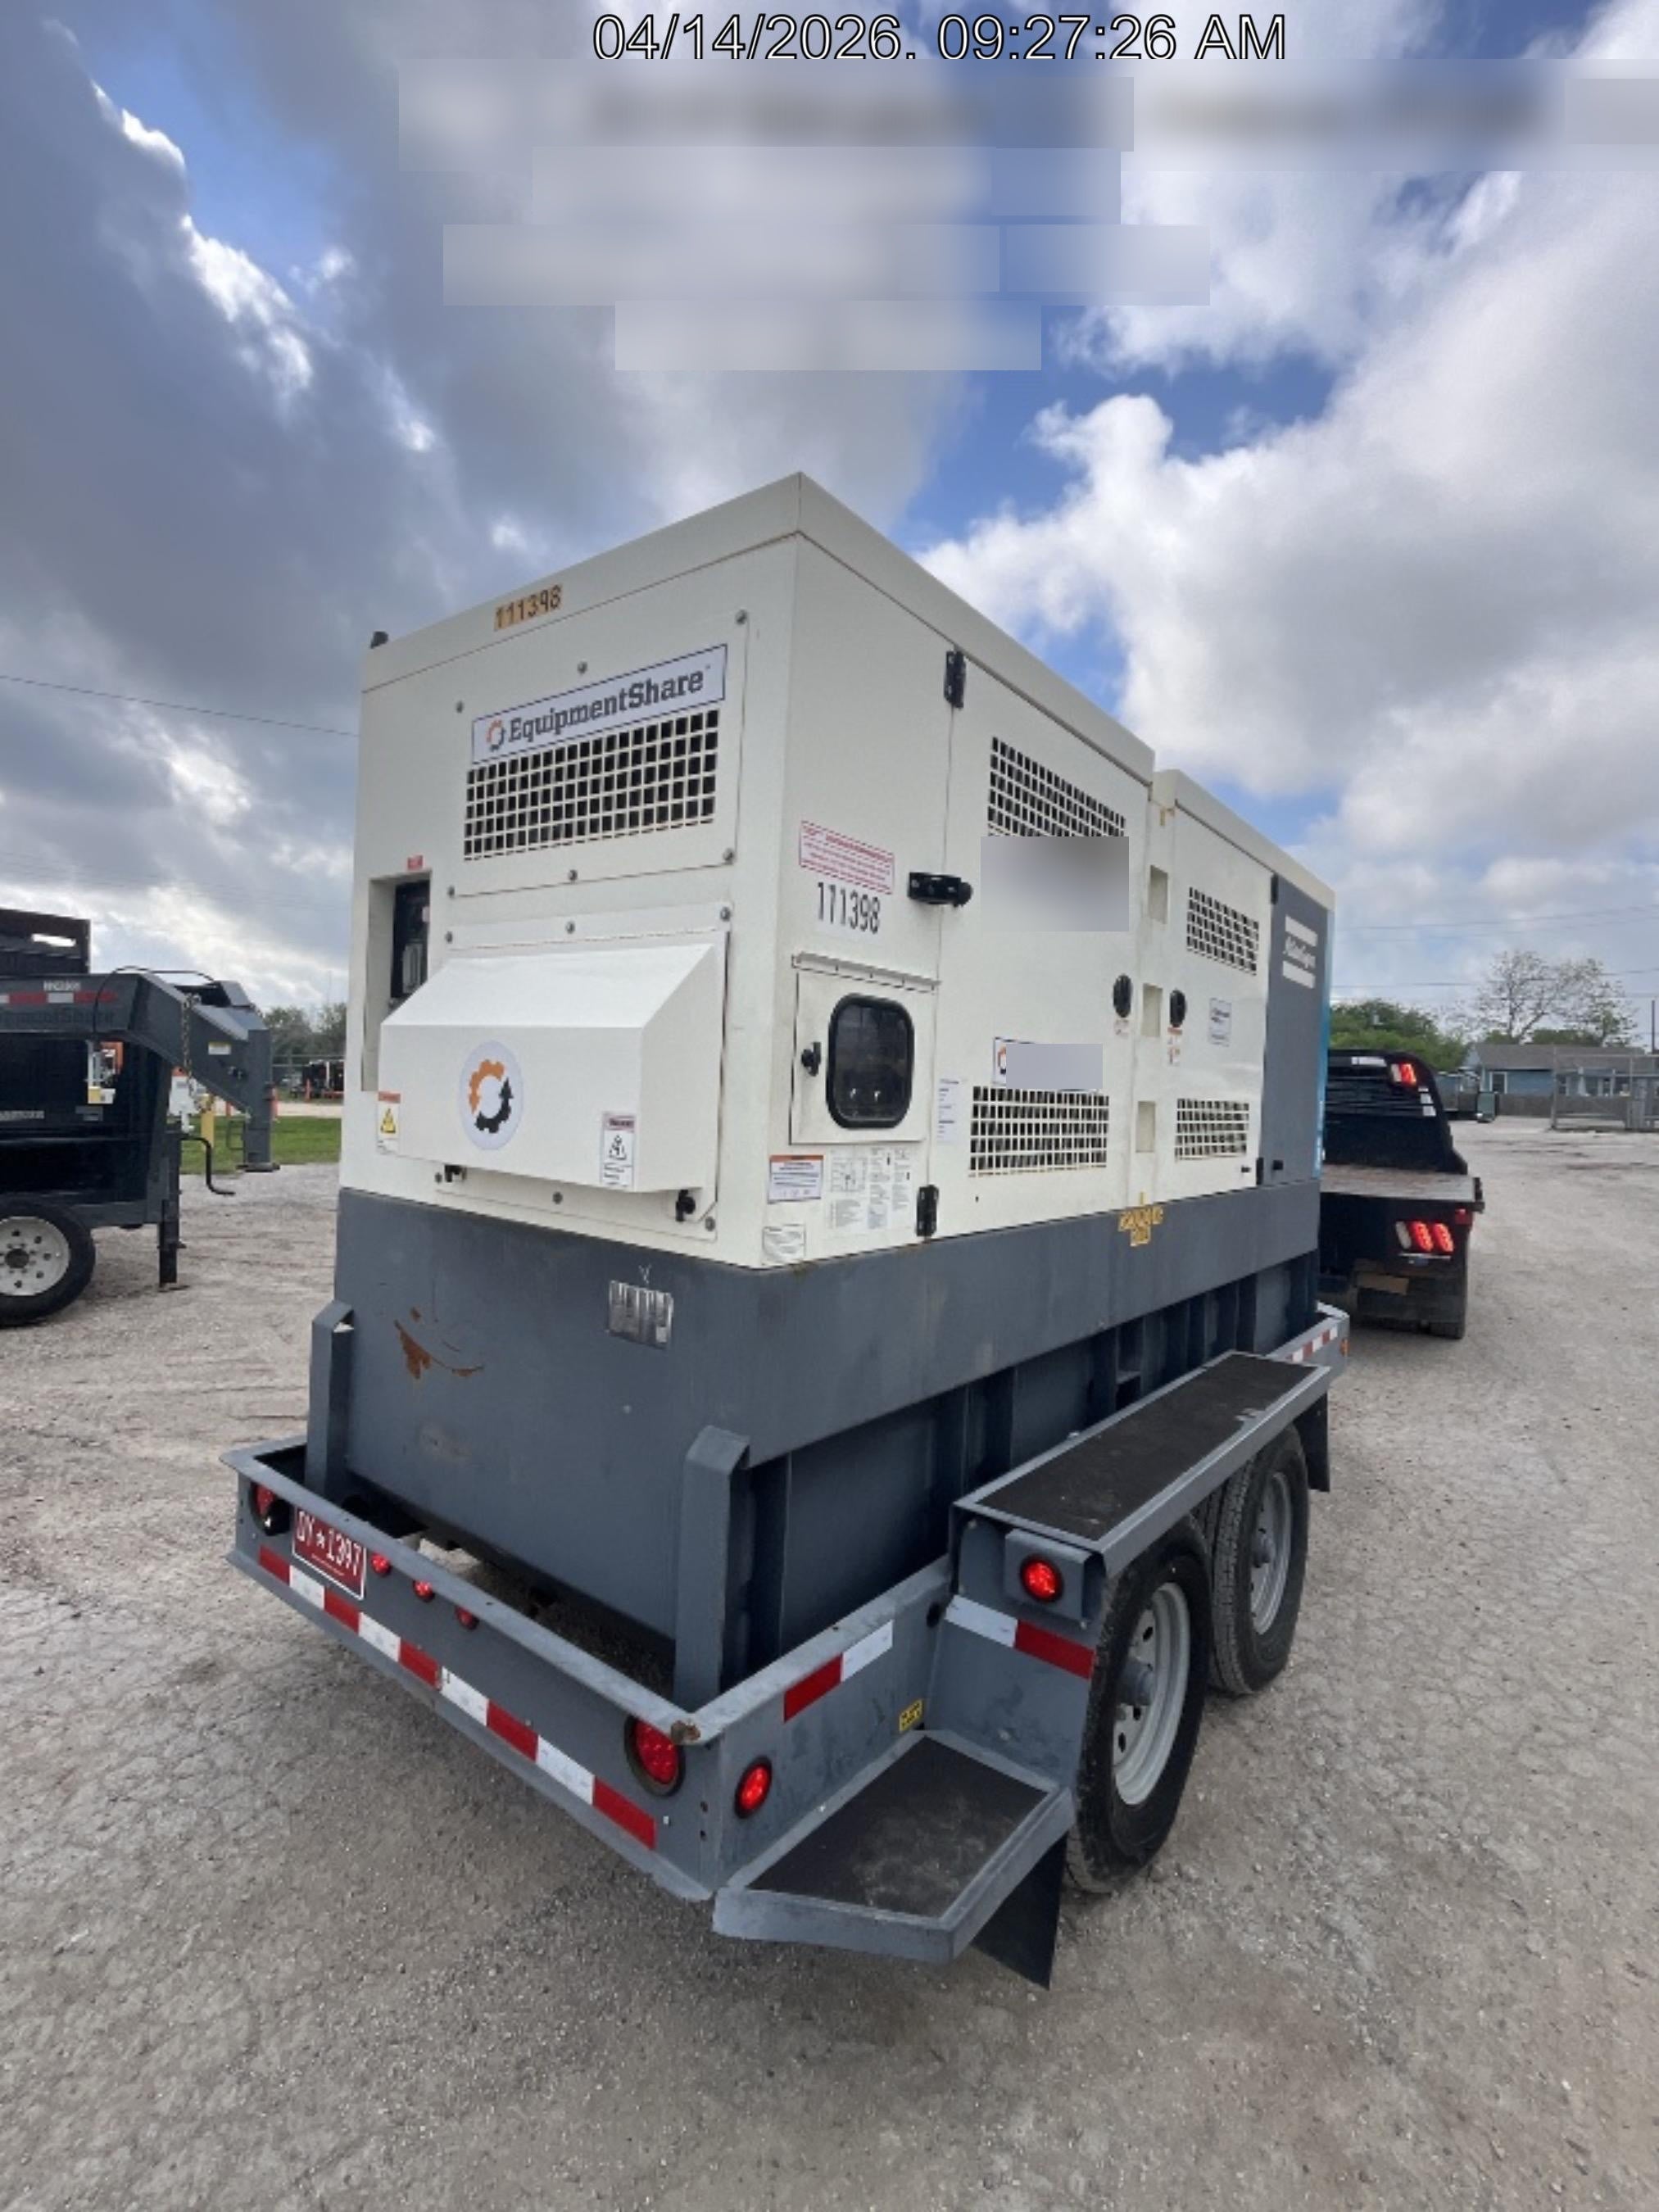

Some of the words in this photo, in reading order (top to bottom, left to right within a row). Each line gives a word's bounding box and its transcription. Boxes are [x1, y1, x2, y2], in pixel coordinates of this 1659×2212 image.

[495, 584, 562, 628] 111398
[509, 669, 705, 742] EquipmentShare
[818, 882, 881, 935] 111398
